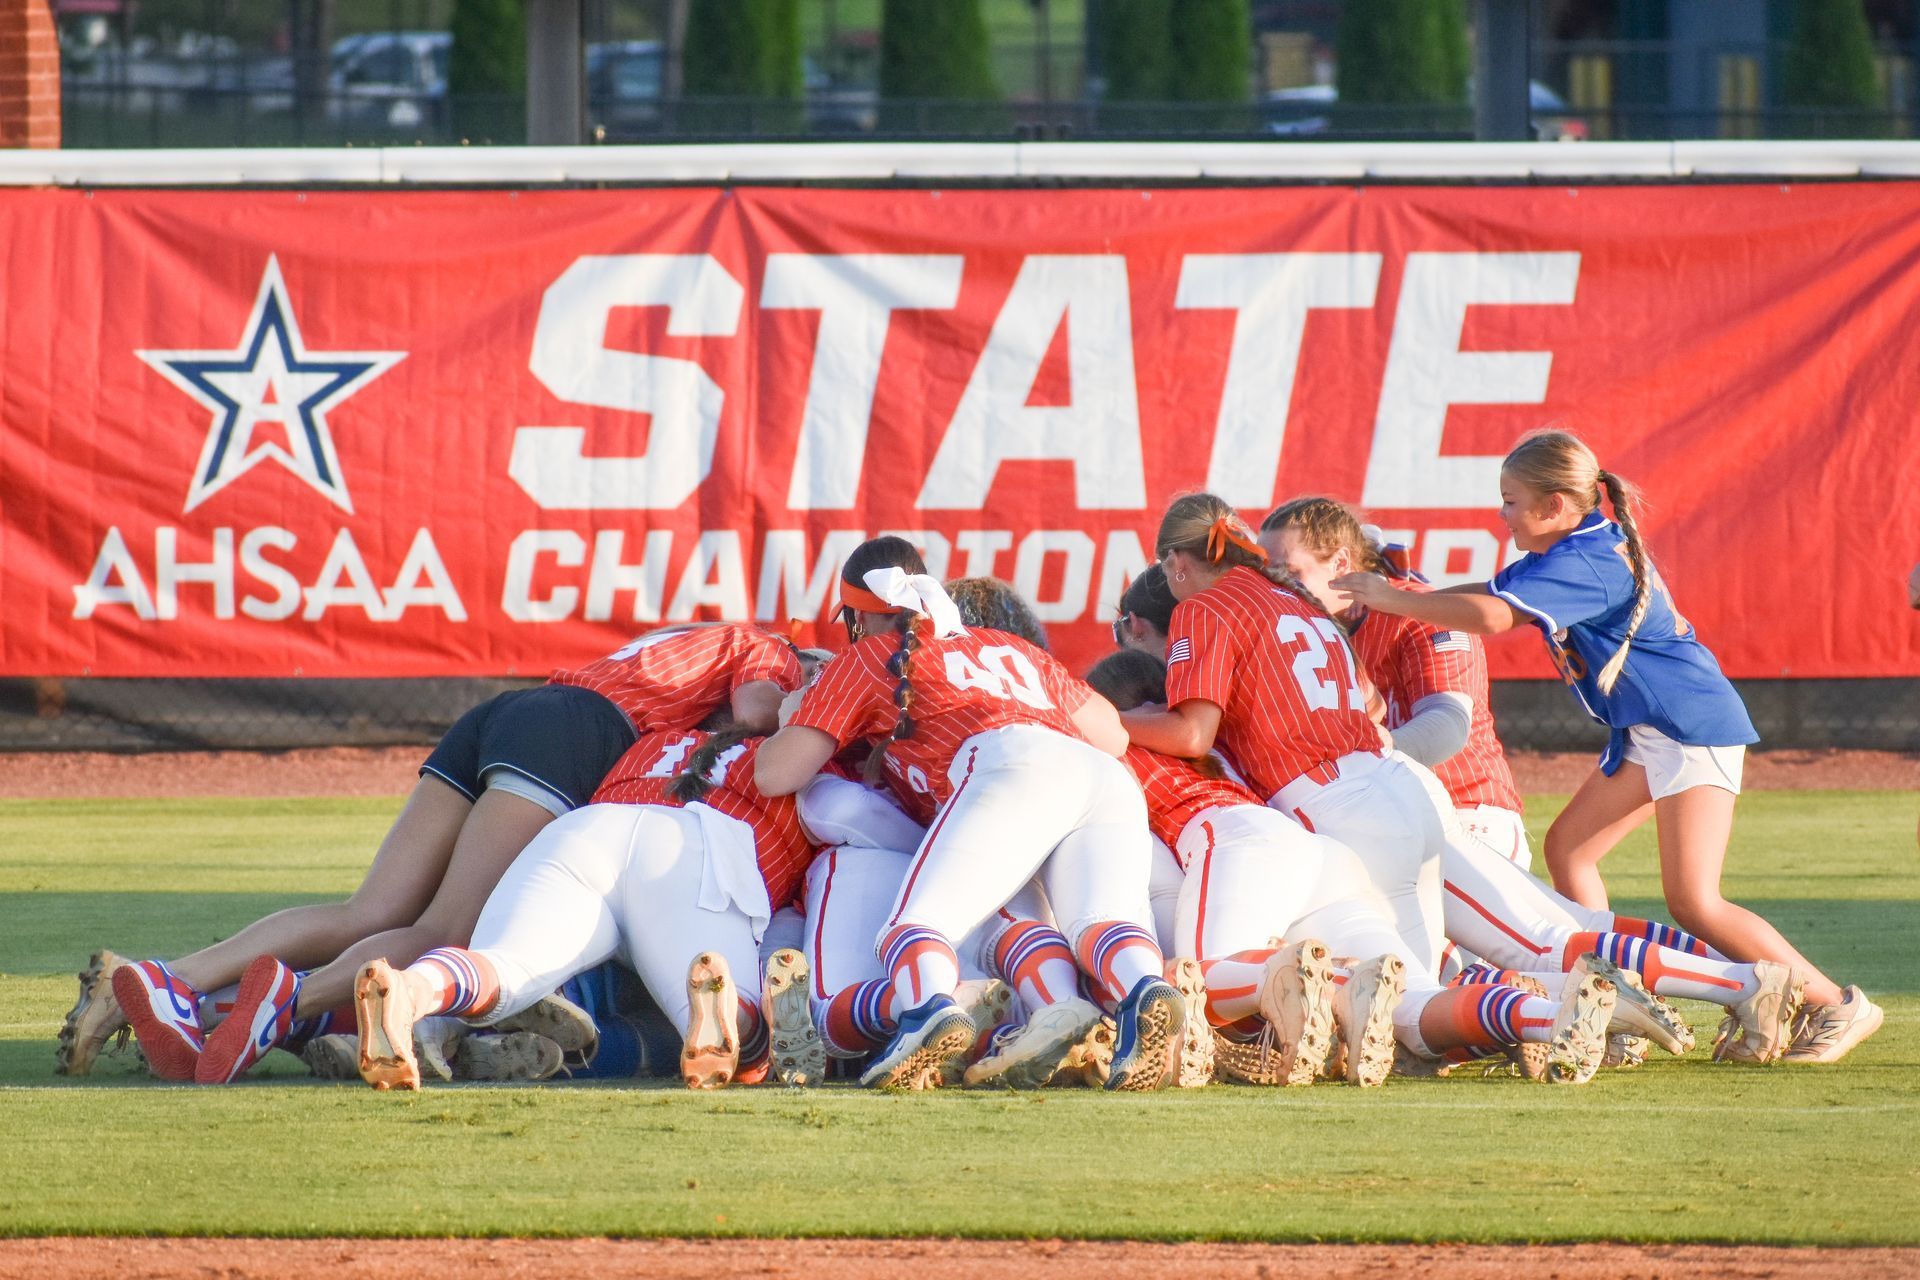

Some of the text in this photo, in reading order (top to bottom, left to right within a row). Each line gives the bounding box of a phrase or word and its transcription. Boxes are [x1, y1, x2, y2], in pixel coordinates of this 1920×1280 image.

[509, 252, 1581, 511] STATE
[74, 526, 468, 622] AHSAA
[943, 644, 1056, 710] 40
